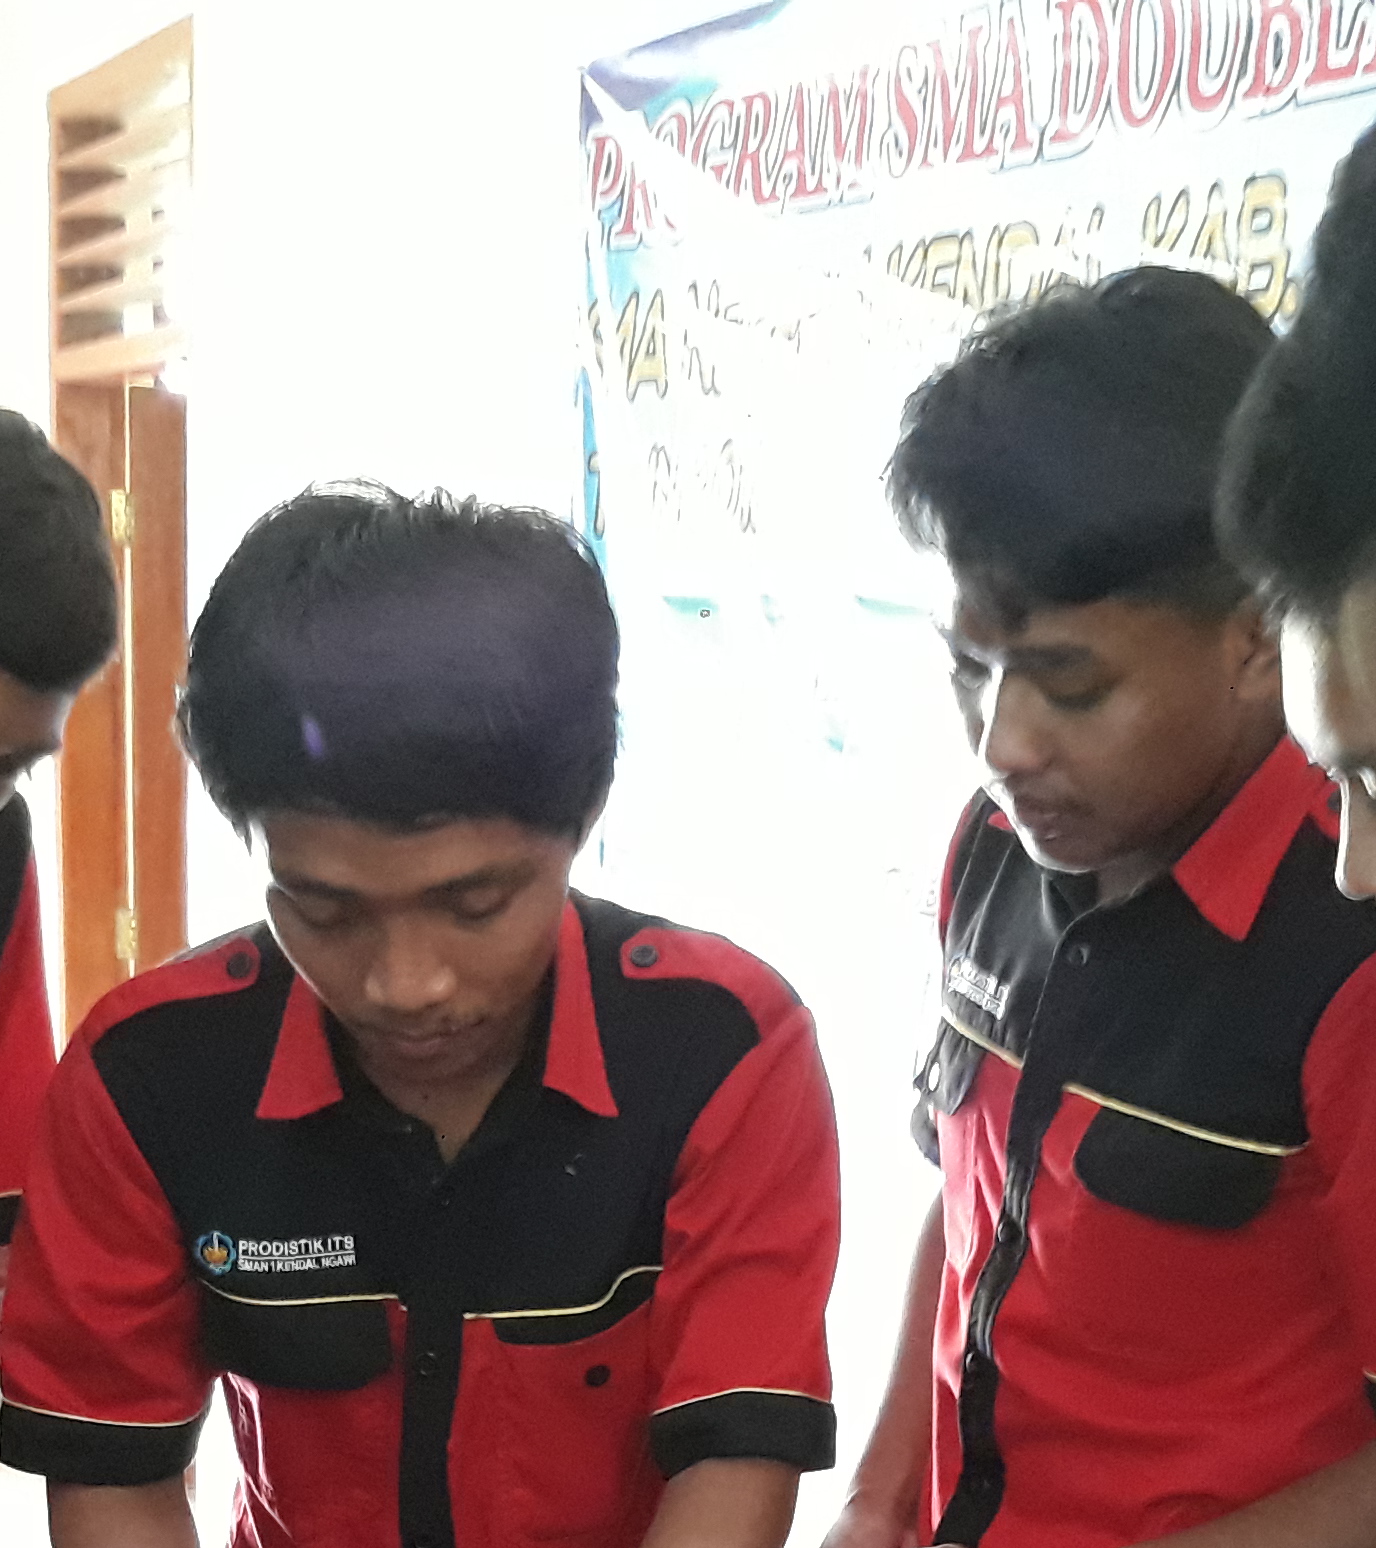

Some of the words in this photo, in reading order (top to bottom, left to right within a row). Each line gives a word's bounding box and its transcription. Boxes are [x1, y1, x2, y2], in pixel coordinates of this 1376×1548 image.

[886, 12, 1035, 178] SMA
[238, 1238, 325, 1257] PRODISTIK
[326, 1235, 355, 1252] ITS
